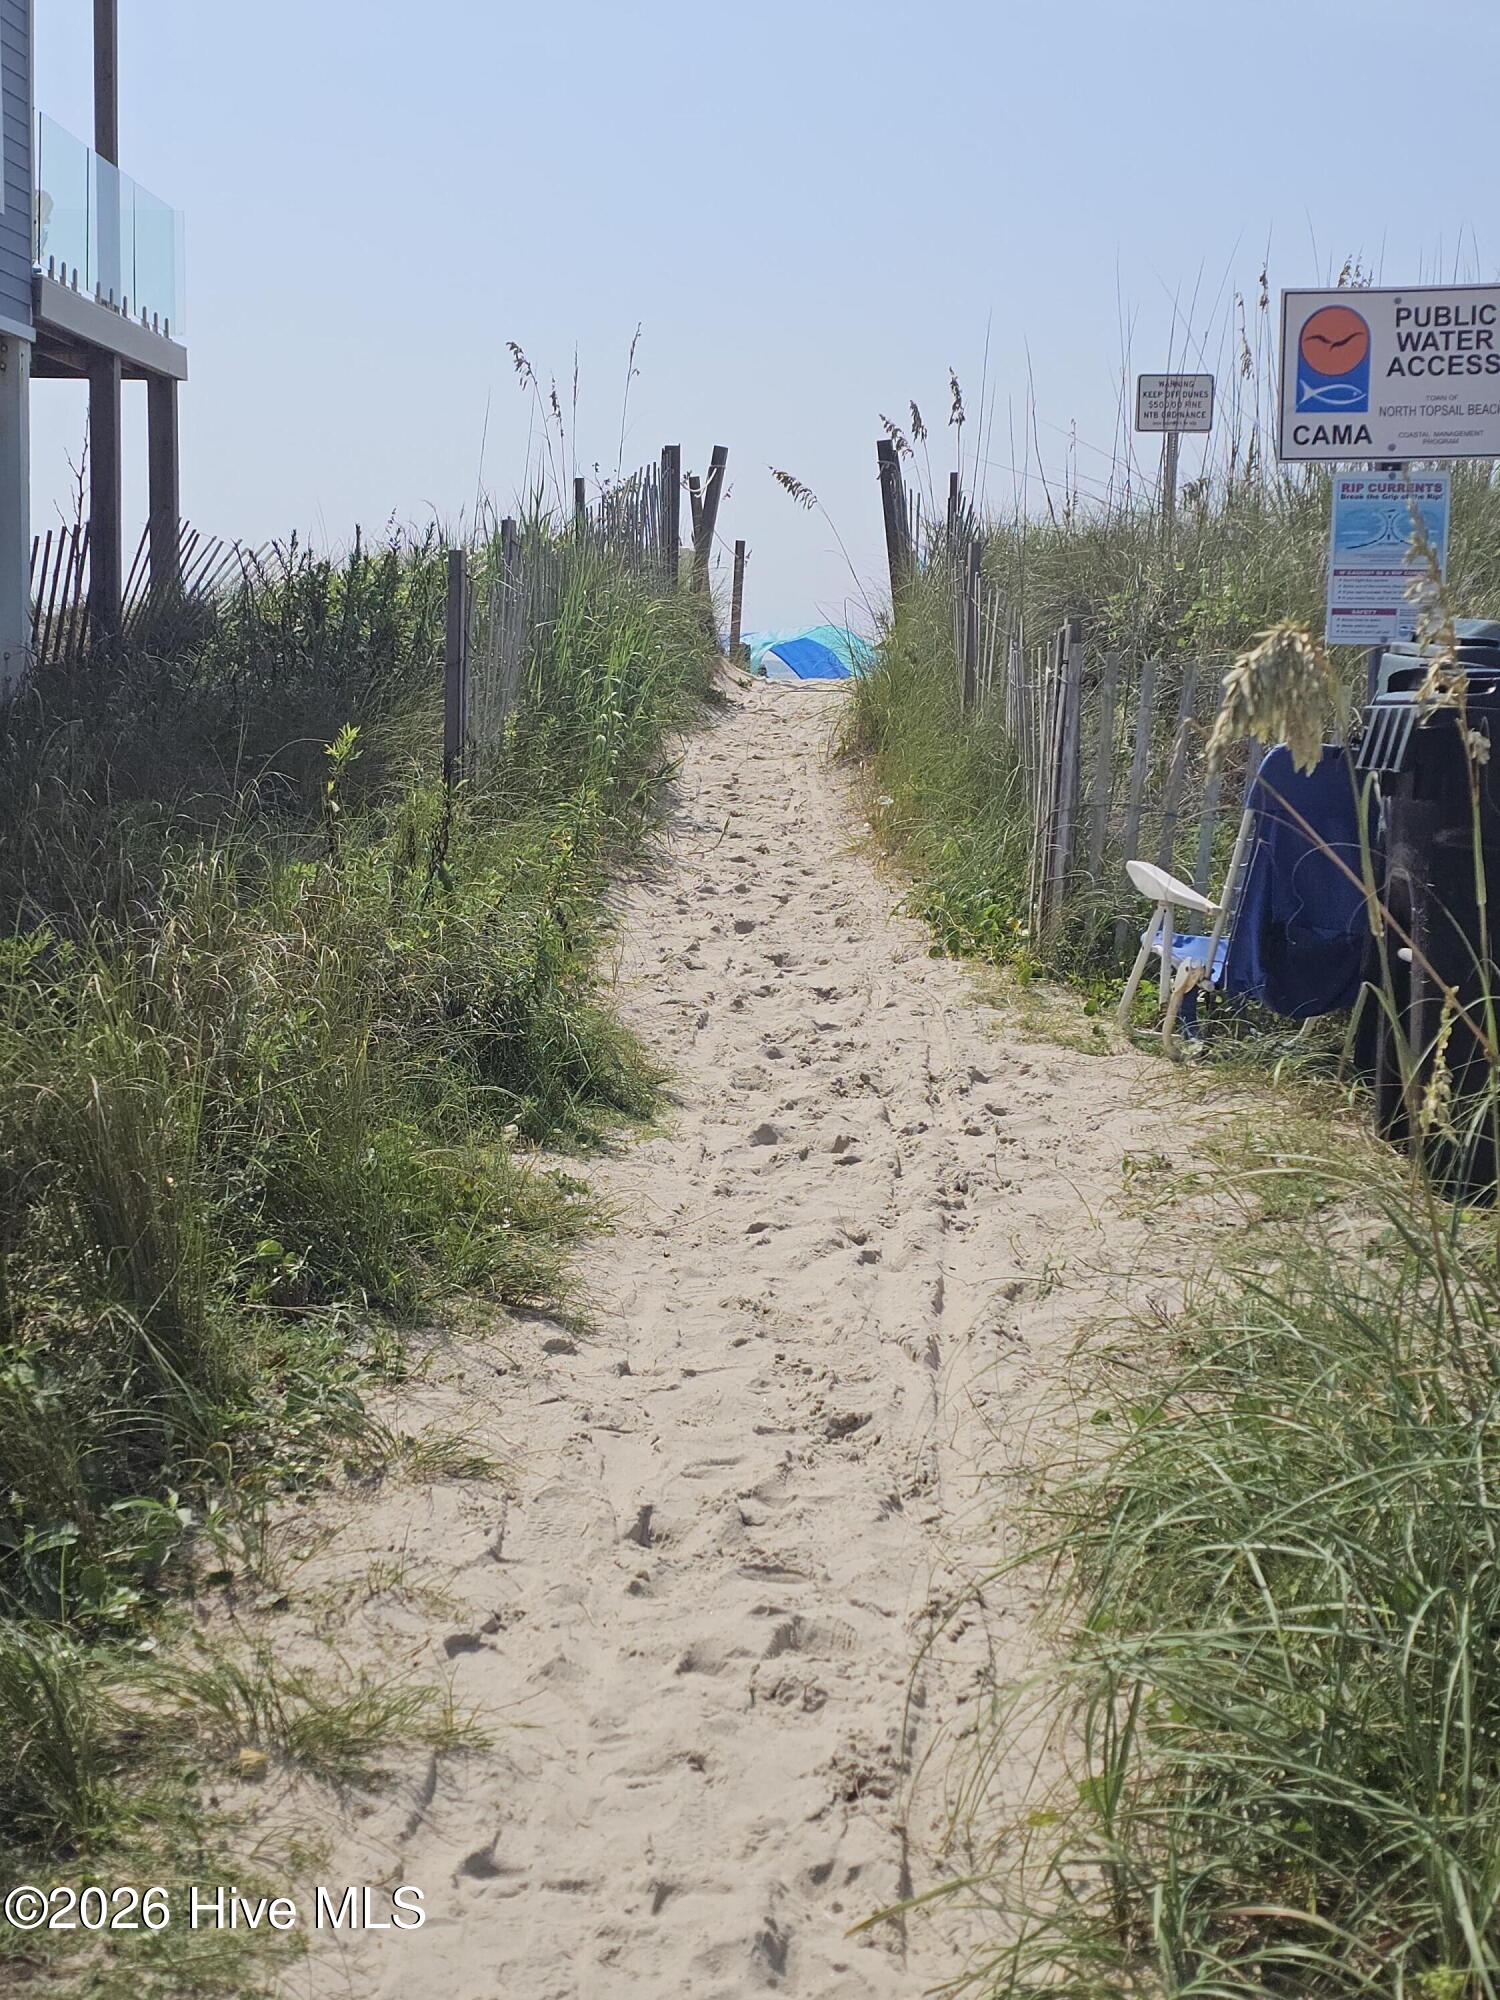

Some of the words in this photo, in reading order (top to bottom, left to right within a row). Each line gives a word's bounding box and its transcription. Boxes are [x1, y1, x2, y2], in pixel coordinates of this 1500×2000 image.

[1396, 304, 1497, 328] PUBLIC
[1397, 329, 1493, 352] WATER
[1386, 353, 1500, 377] ACCESS
[1142, 390, 1163, 399] KEEP
[1165, 390, 1180, 399] OFF
[1182, 390, 1209, 399] DUNES
[1448, 393, 1459, 401] OF
[1184, 400, 1203, 409] FINE
[1379, 405, 1417, 417] NORTH
[1420, 404, 1465, 417] TOPSAIL
[1292, 424, 1373, 446] CAMA
[1341, 483, 1364, 493] RIP
[1367, 482, 1443, 493] CURRENTS
